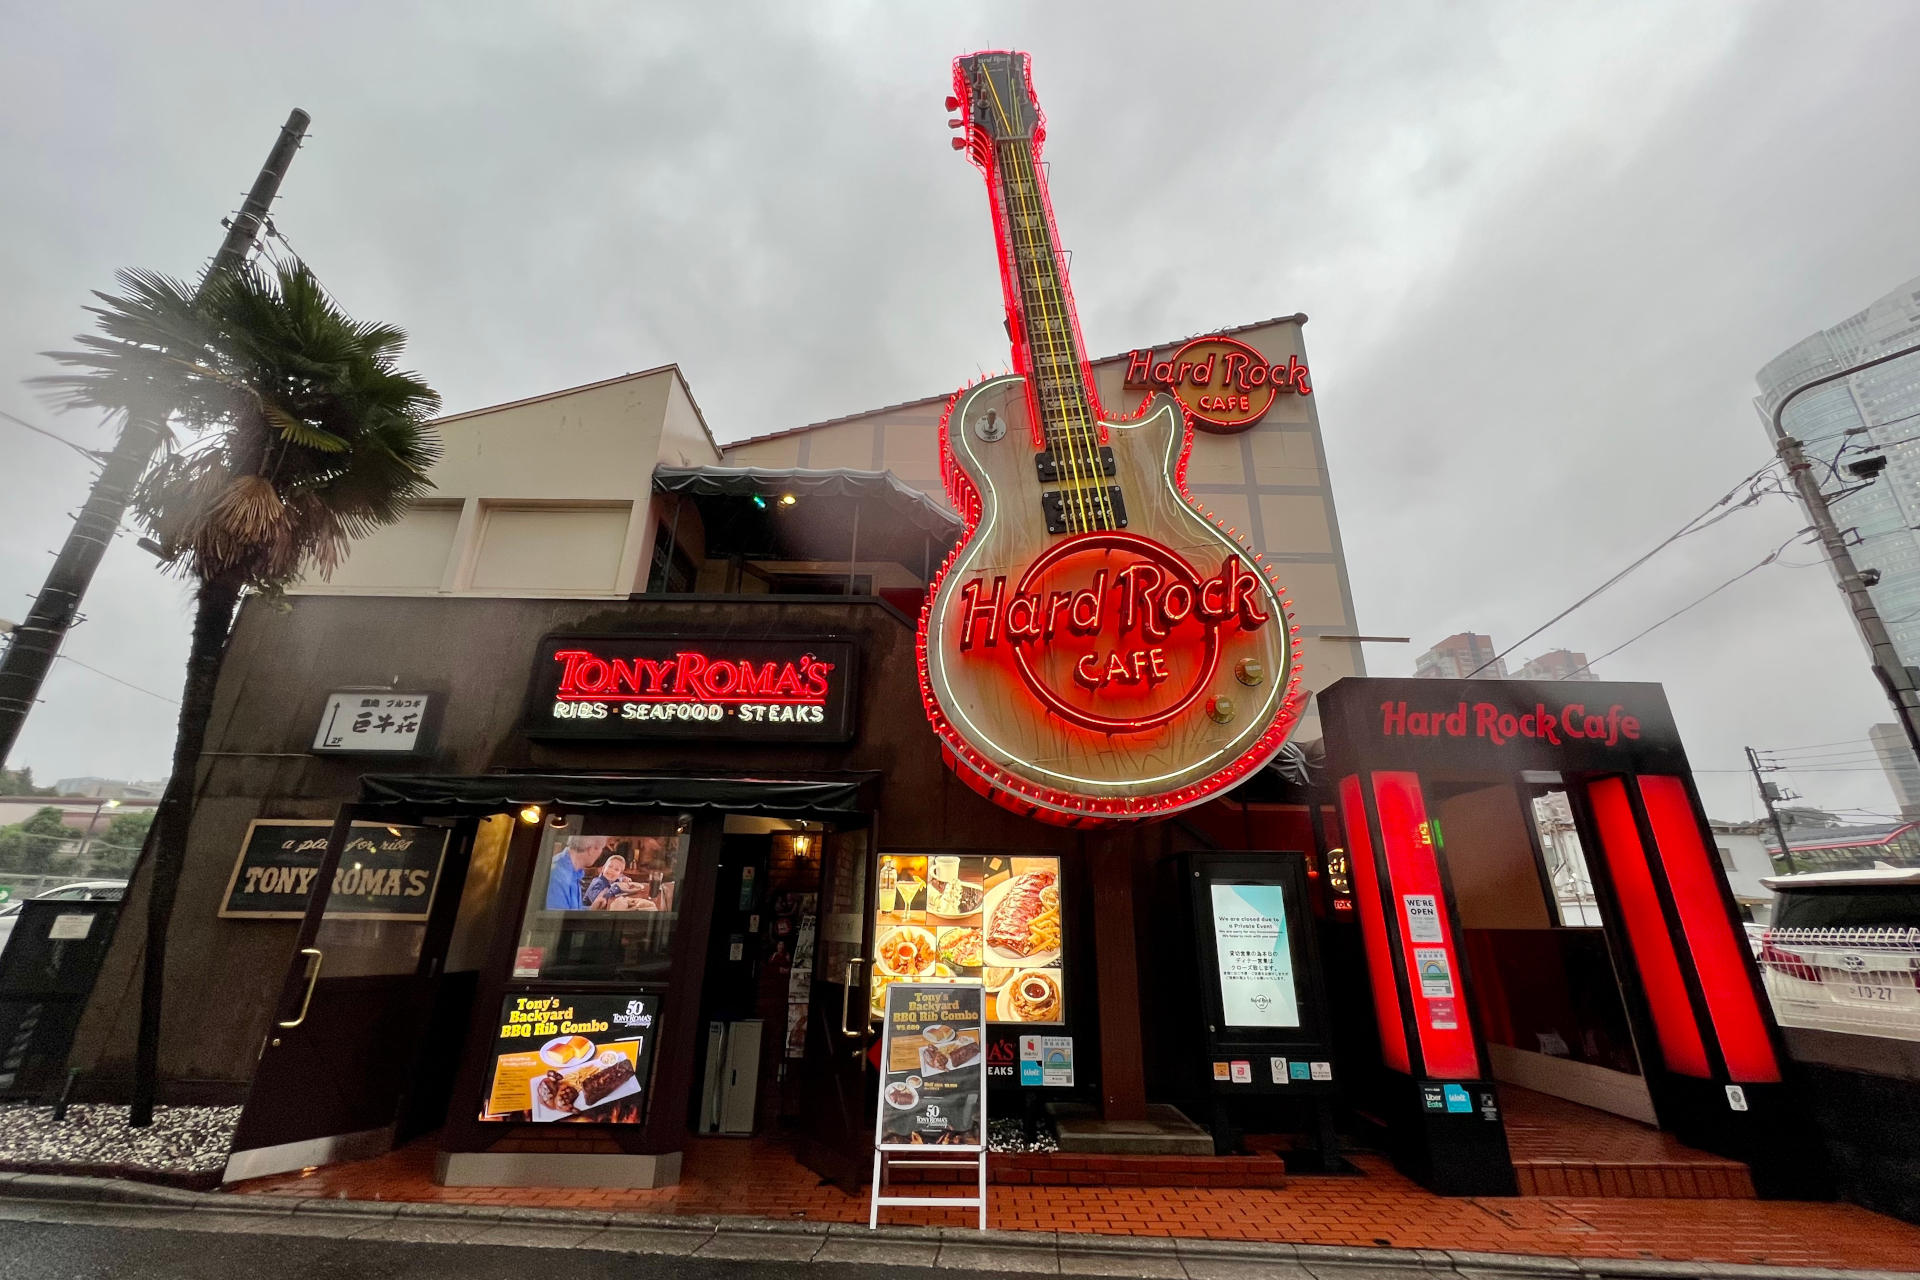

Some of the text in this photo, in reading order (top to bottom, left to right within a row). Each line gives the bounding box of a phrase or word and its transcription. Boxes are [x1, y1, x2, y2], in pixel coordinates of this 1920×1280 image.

[1124, 350, 1312, 396] Hard Rock
[1199, 395, 1250, 412] CAFE
[959, 554, 1270, 652] Hard Rock
[1073, 648, 1169, 693] CAFE
[553, 702, 824, 723] RIBS SEAFOOD STEAKS
[1380, 701, 1640, 746] Hard Rock Cafe
[281, 837, 413, 853] a pla for ribs
[244, 866, 430, 897] TONY ROMA'S
[1407, 899, 1434, 907] WE'RE
[517, 996, 560, 1011] Tony's
[914, 992, 949, 1002] Tony's
[626, 1000, 643, 1015] 50
[909, 1000, 960, 1012] Backyard
[509, 1007, 574, 1024] Backyard
[893, 1010, 978, 1022] BBQ Rib Combo
[500, 1019, 609, 1038] BBQ Rib Combo
[988, 1066, 1013, 1075] EAKS
[1425, 1093, 1441, 1101] Uber
[926, 1104, 940, 1117] 50
